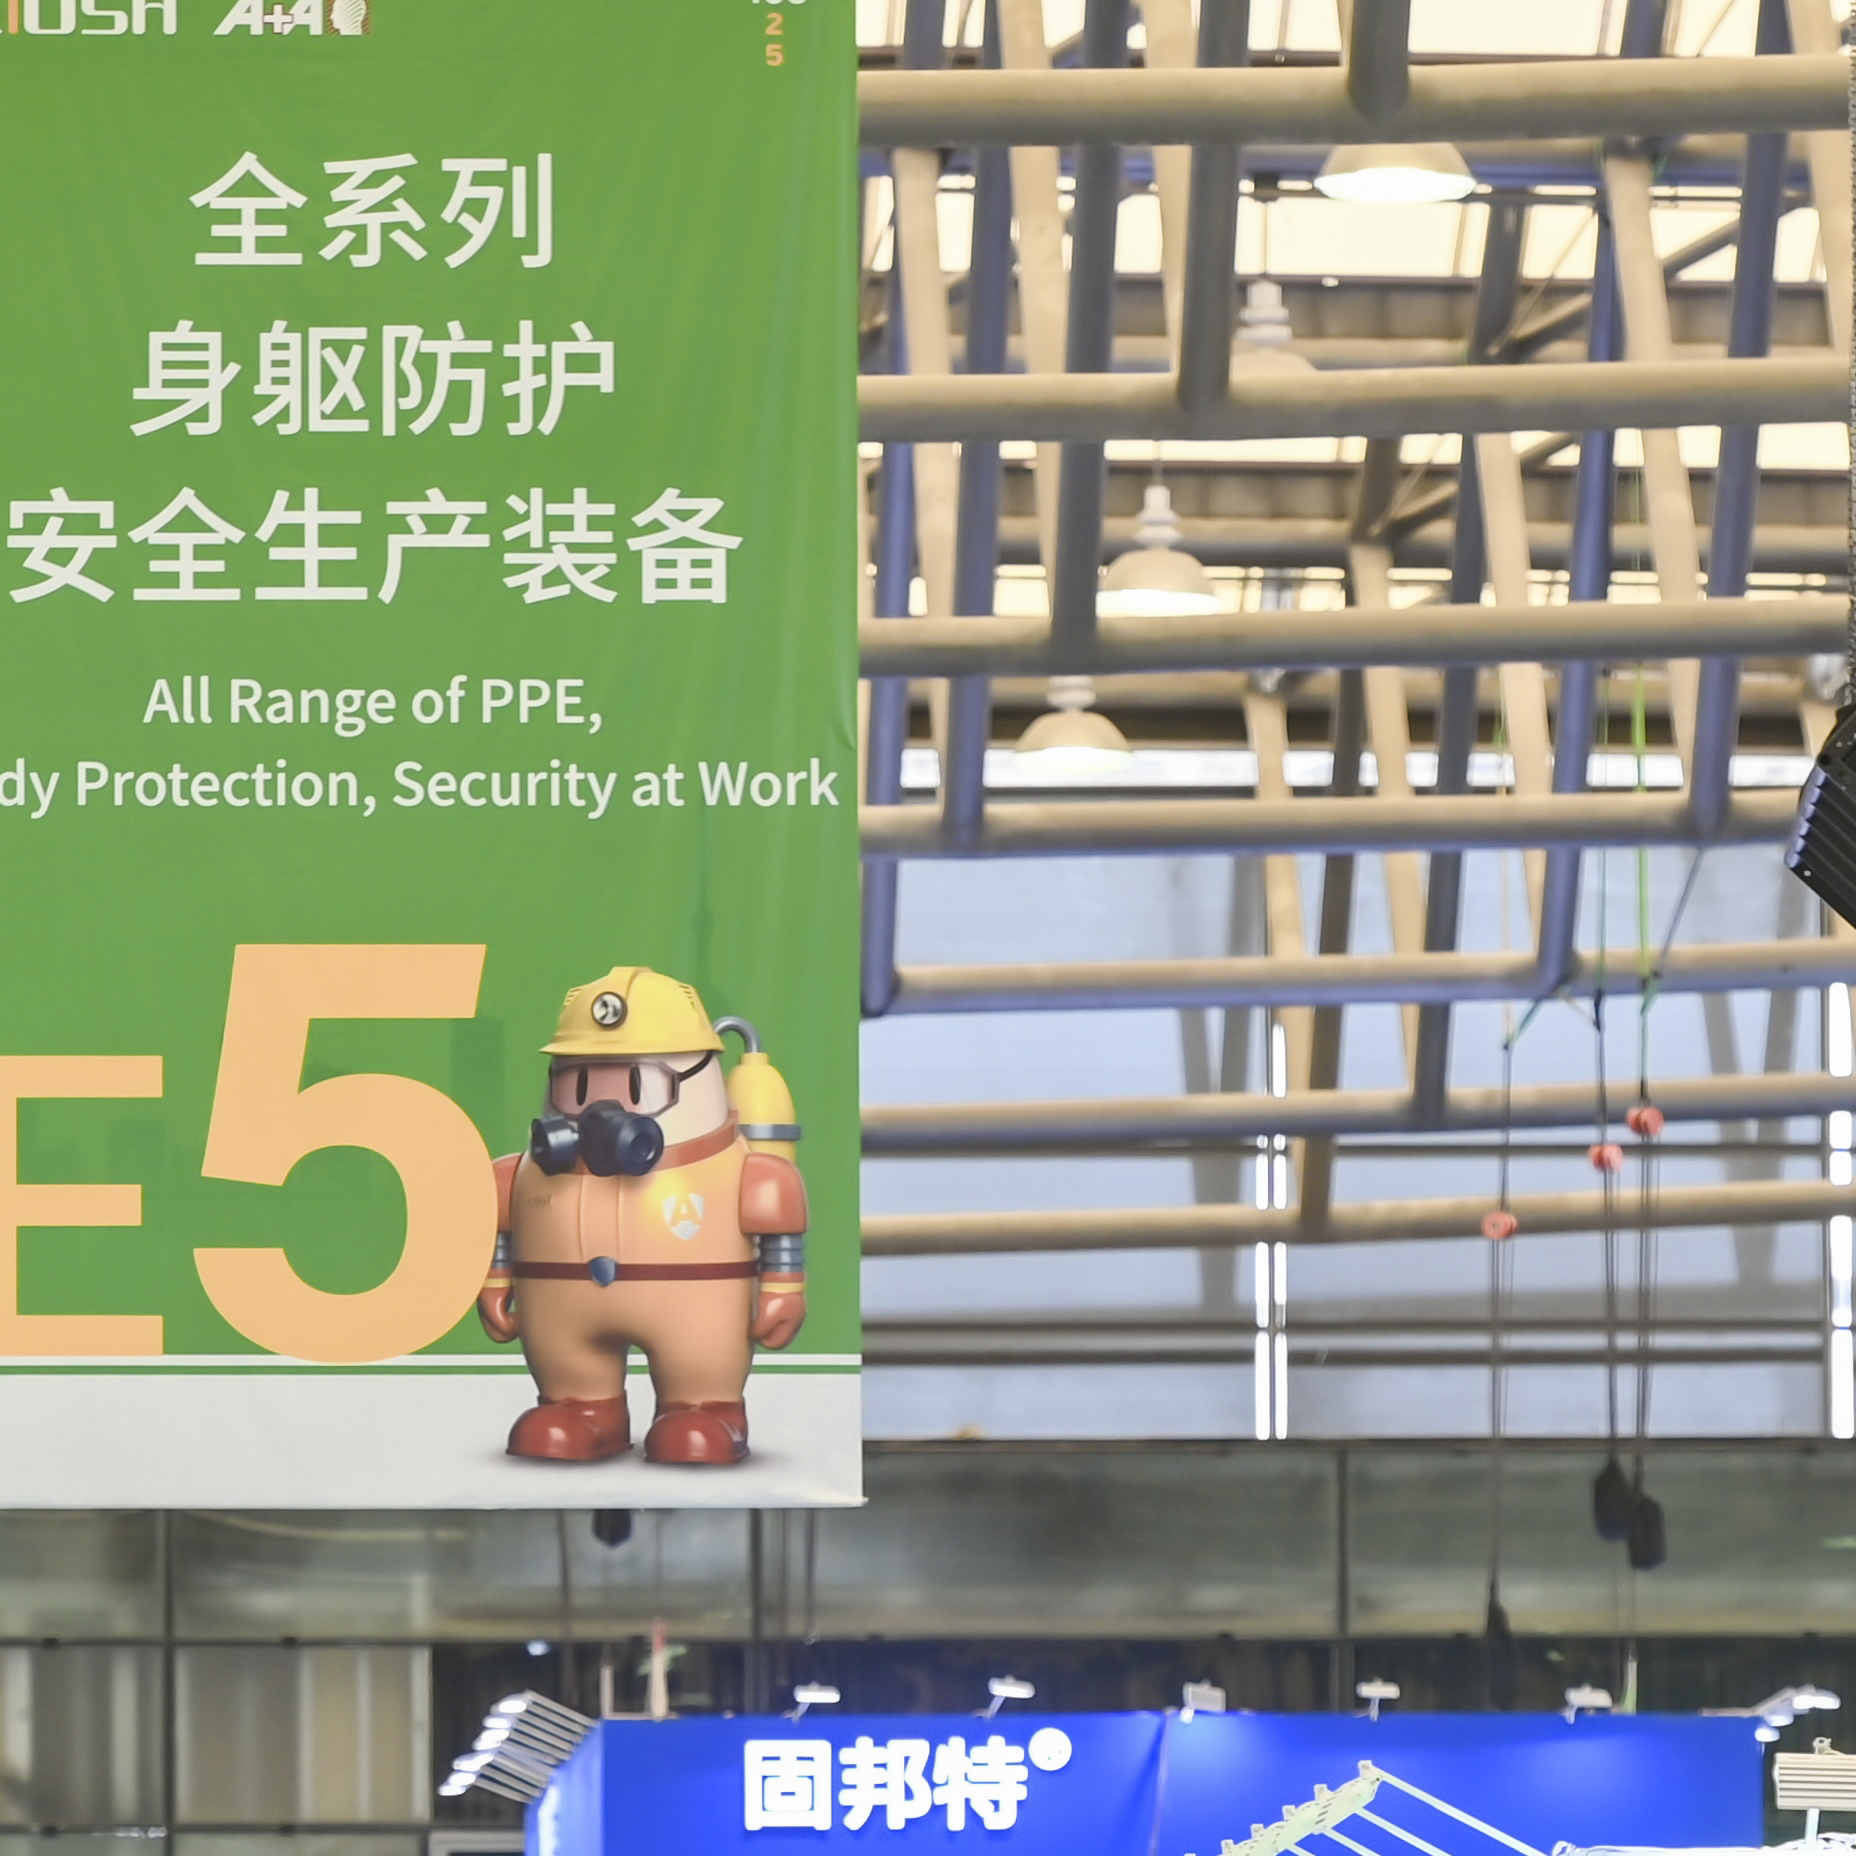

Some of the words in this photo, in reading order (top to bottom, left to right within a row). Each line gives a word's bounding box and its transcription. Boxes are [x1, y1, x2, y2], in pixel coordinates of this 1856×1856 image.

[189, 151, 554, 269] 全系列
[129, 320, 616, 437] 身躯防护
[6, 487, 743, 605] 安全生产装备
[143, 676, 211, 724] All
[229, 678, 396, 738] Range
[410, 674, 465, 724] of
[480, 678, 603, 735] PPE,
[77, 758, 378, 816] Protection,
[393, 758, 617, 819] Security
[632, 765, 685, 807] at
[698, 757, 840, 807] Work
[744, 1736, 1029, 1832] 固邦特
